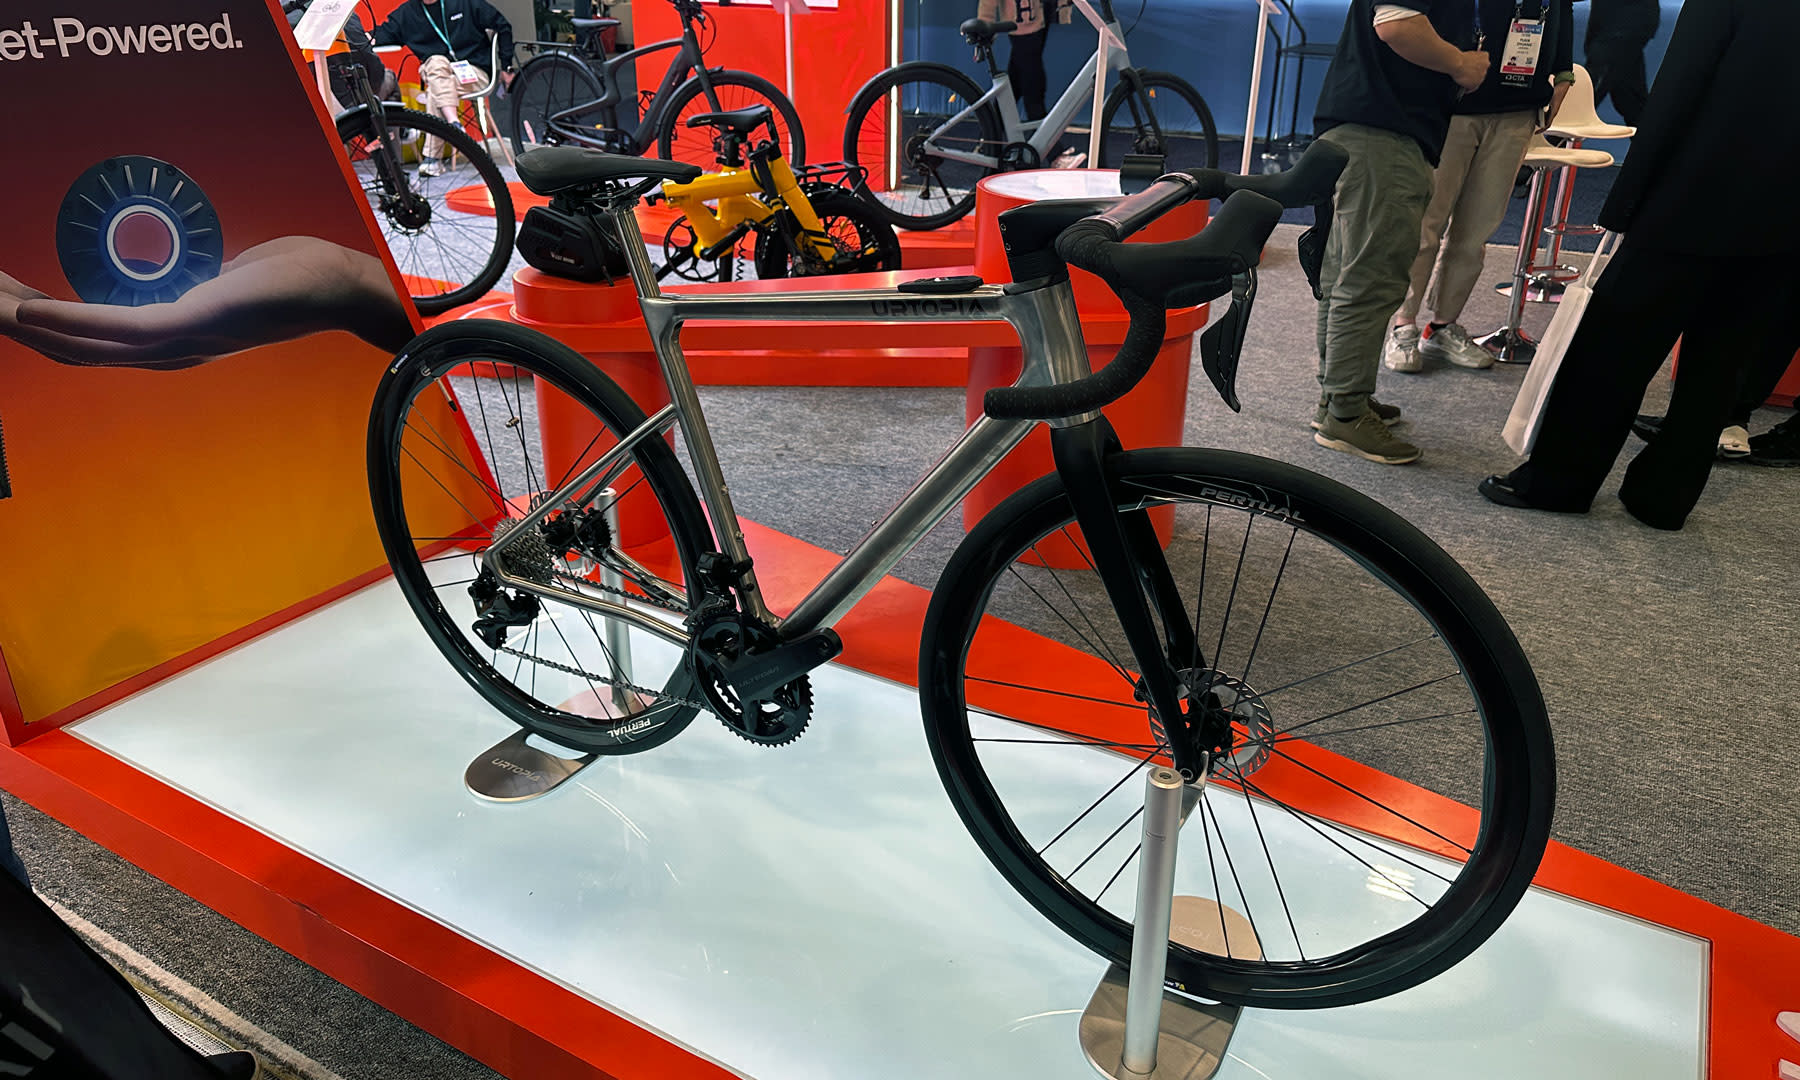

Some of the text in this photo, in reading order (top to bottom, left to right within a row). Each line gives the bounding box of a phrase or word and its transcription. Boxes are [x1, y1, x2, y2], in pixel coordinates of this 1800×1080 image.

[0, 13, 244, 61] et-Powered.
[871, 299, 987, 317] URTOPIA
[1200, 487, 1304, 522] PERTUAL
[607, 718, 651, 738] PERTUAL
[491, 757, 542, 783] URTOPIA
